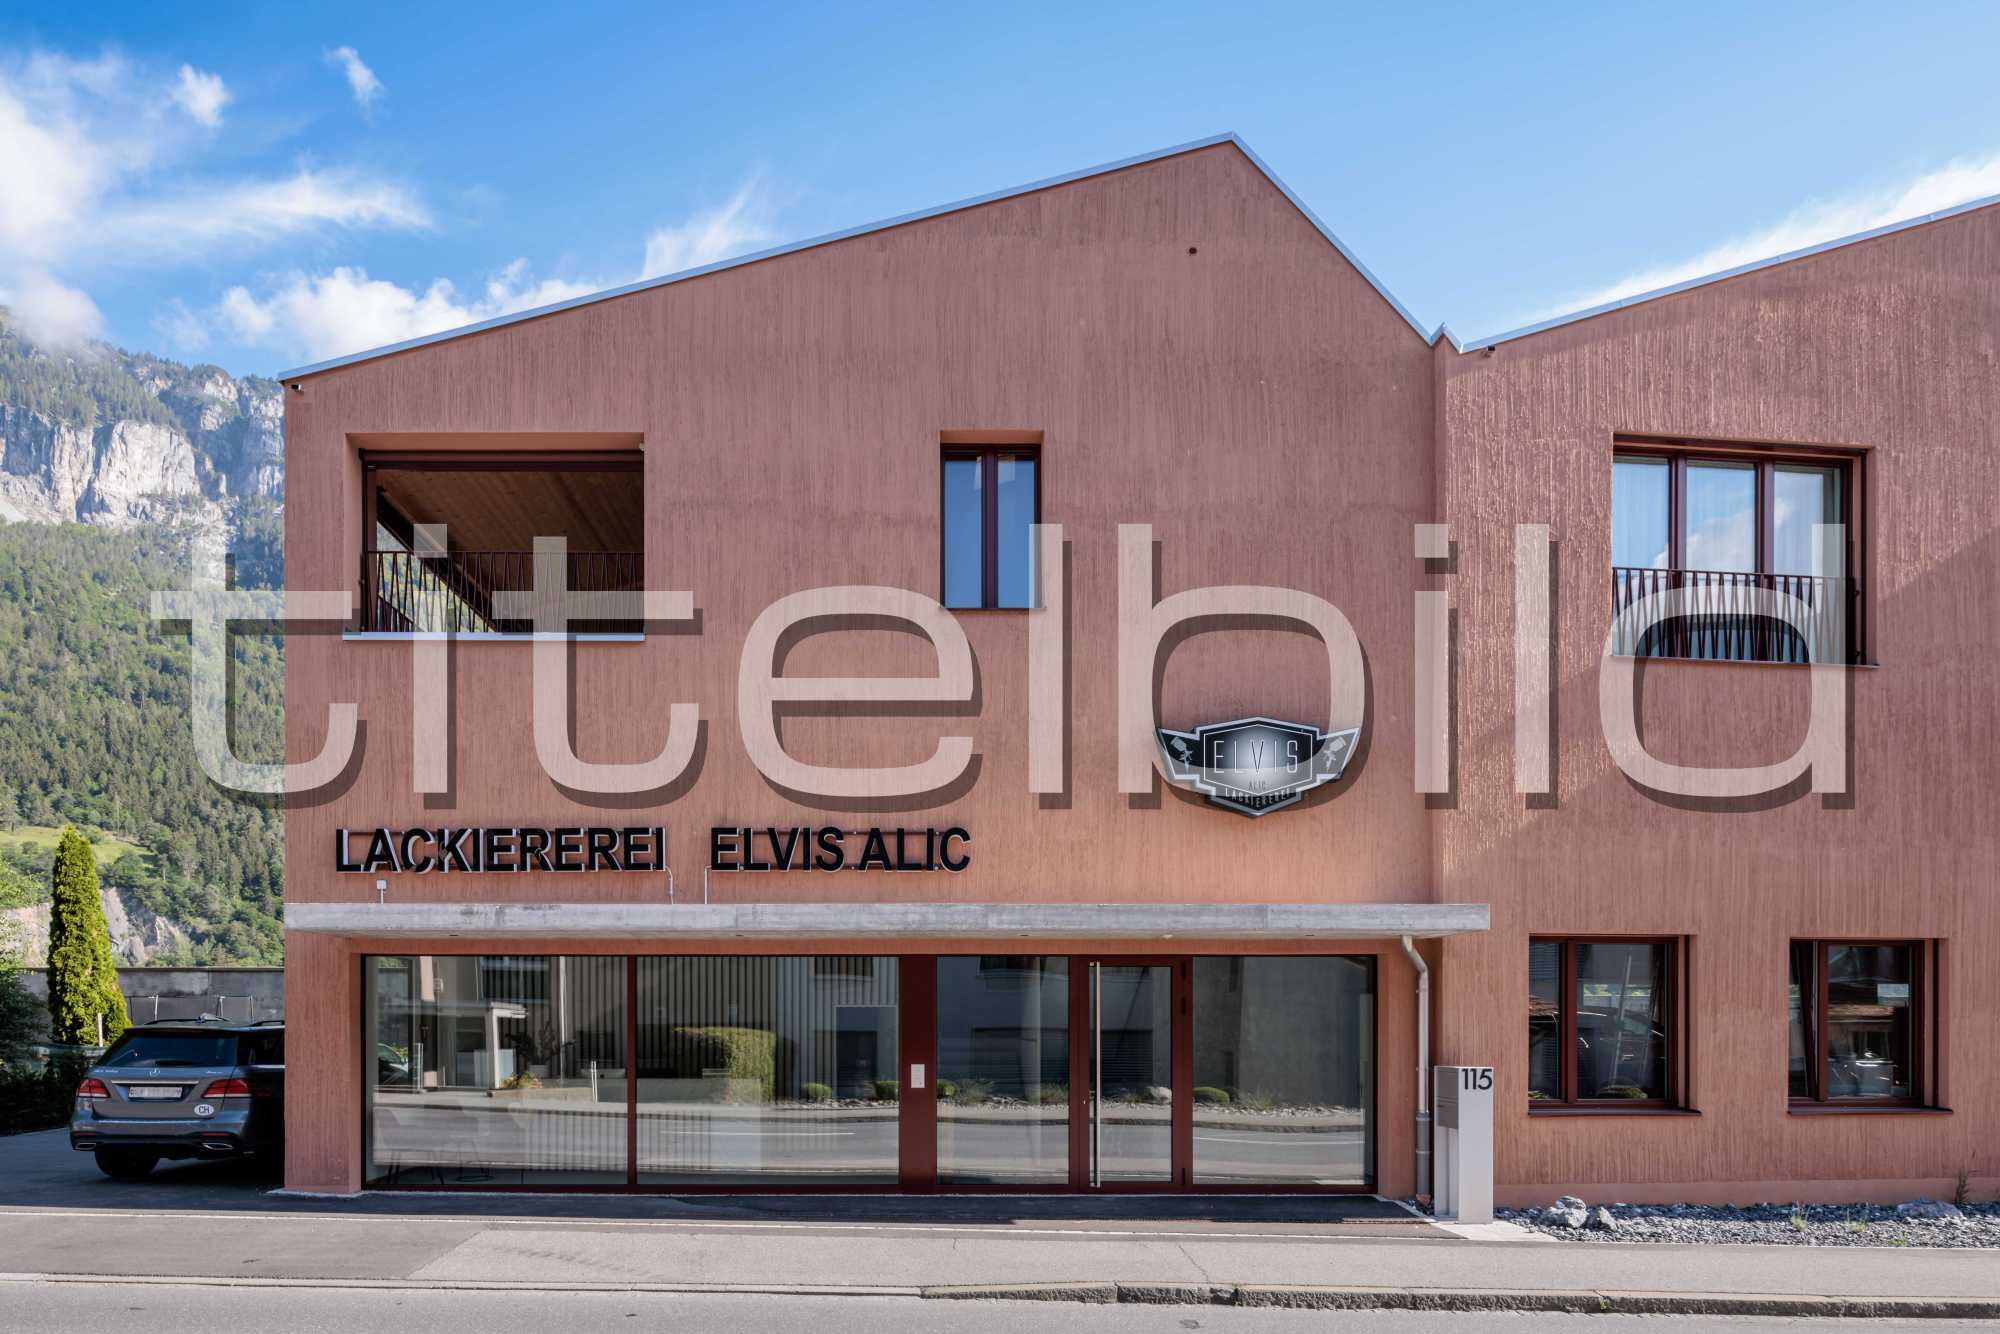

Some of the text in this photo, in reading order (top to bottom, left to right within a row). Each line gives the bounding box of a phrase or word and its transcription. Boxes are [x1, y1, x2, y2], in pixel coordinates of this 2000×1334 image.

[1213, 740, 1298, 774] ELVIS
[335, 826, 971, 873] LACKIEREREI ELVIS ALIC
[1461, 1068, 1493, 1090] 115
[198, 1104, 210, 1114] CH
